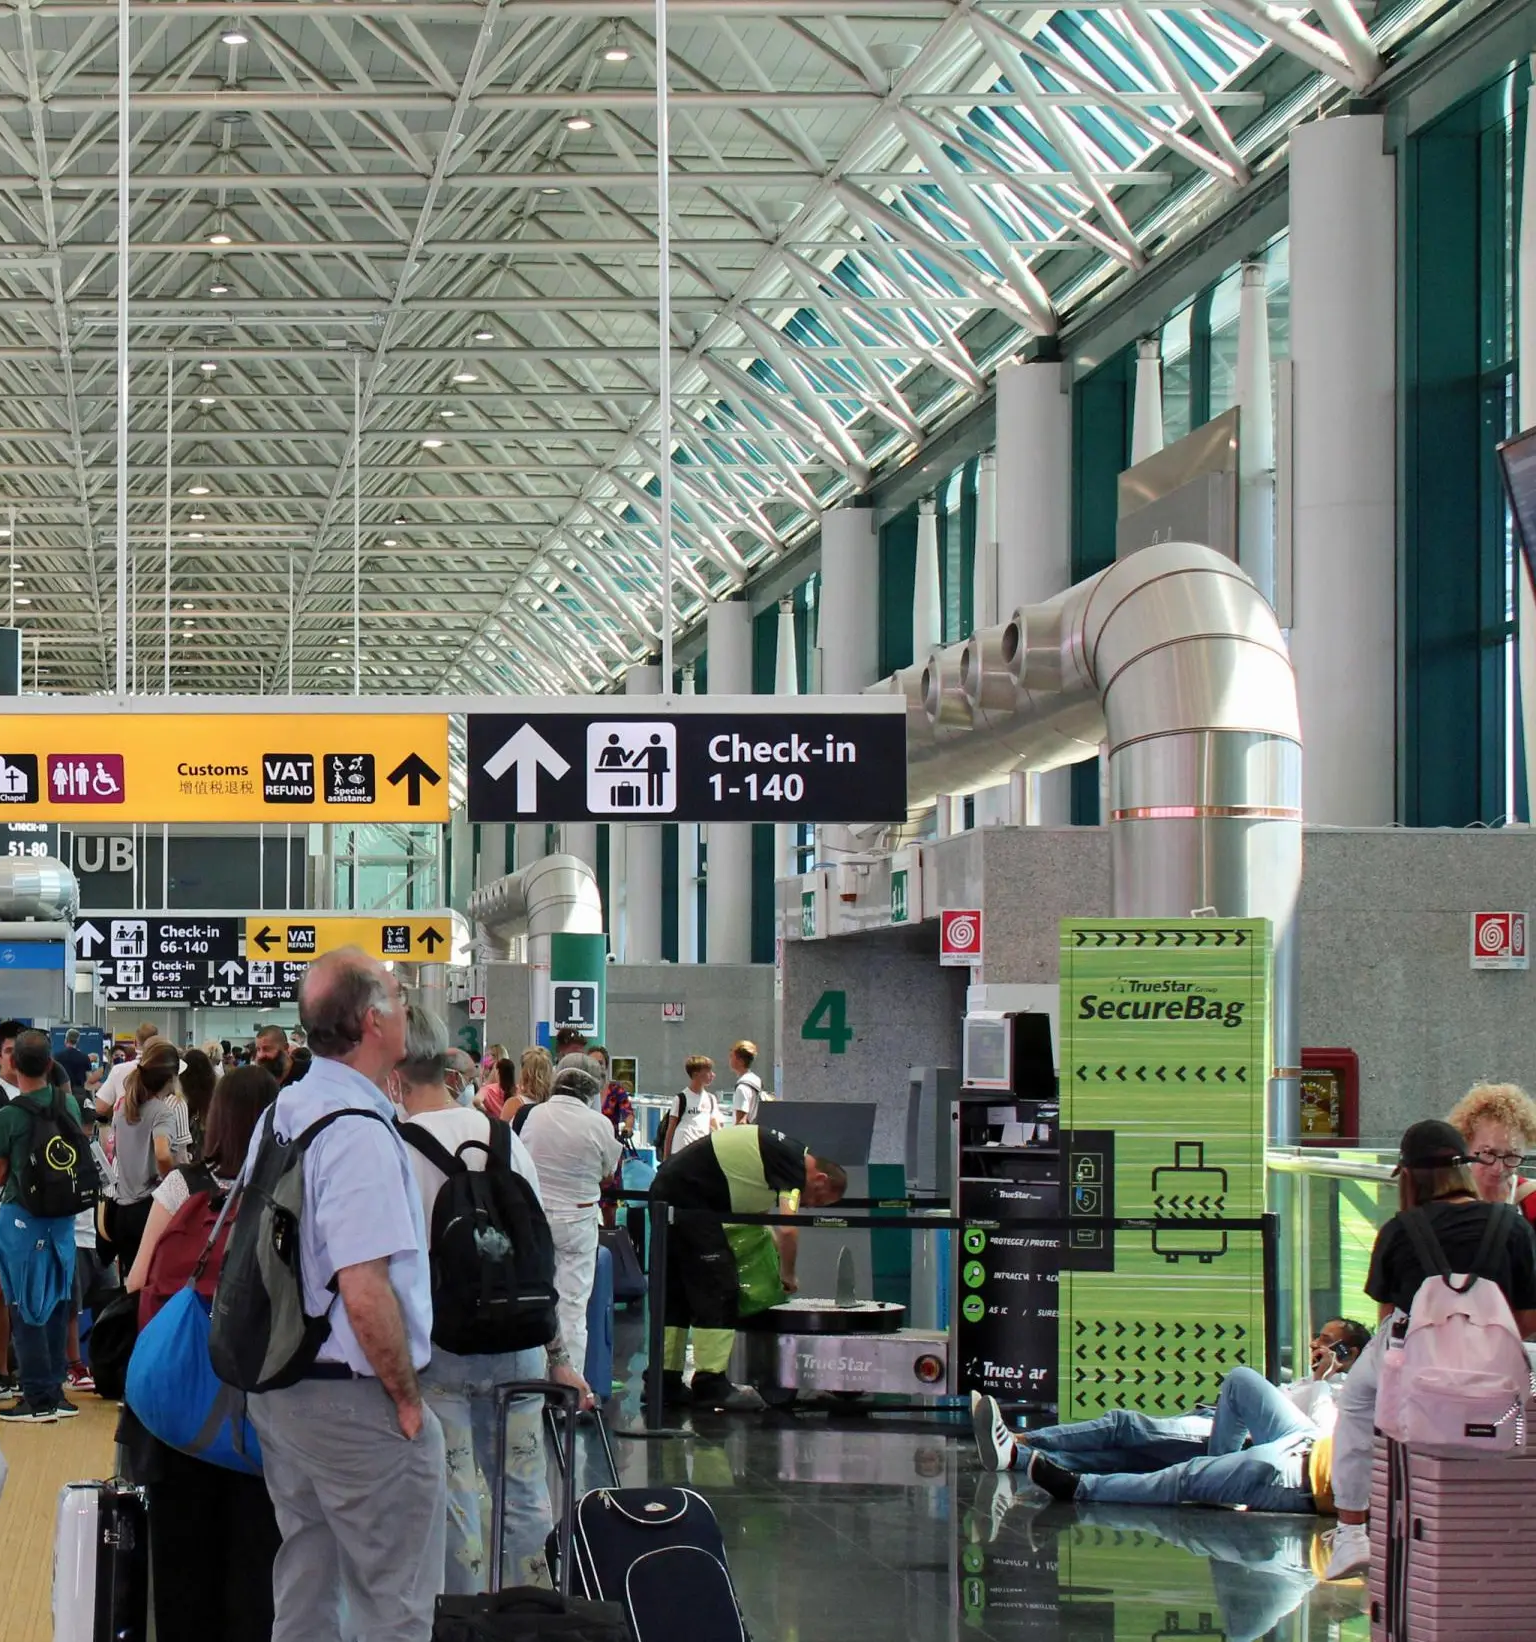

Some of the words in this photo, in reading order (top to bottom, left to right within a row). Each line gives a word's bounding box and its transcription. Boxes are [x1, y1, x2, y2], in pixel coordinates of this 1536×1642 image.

[707, 733, 857, 764] Check-in
[177, 762, 249, 777] Customs
[264, 761, 313, 781] VAT
[265, 785, 313, 796] REFUND
[333, 786, 366, 797] Special
[708, 773, 805, 802] 1-140
[0, 794, 26, 803] Chapel
[327, 794, 372, 803] assistance
[7, 840, 49, 857] 51-80
[77, 836, 135, 873] UB
[159, 924, 220, 939] Check-in
[288, 930, 315, 943] VAT
[160, 941, 209, 954] 66-140
[151, 961, 196, 971] Check-in
[283, 961, 309, 972] Chec
[152, 972, 181, 982] 66-95
[283, 973, 305, 983] 96-
[1128, 980, 1194, 993] TrueStar
[1078, 994, 1246, 1028] SecureBag
[555, 1021, 594, 1030] Information
[800, 990, 853, 1054] 4
[1029, 1239, 1061, 1248] PROTEC
[802, 1354, 873, 1373] TrueStar
[983, 1361, 1048, 1380] TrueSar
